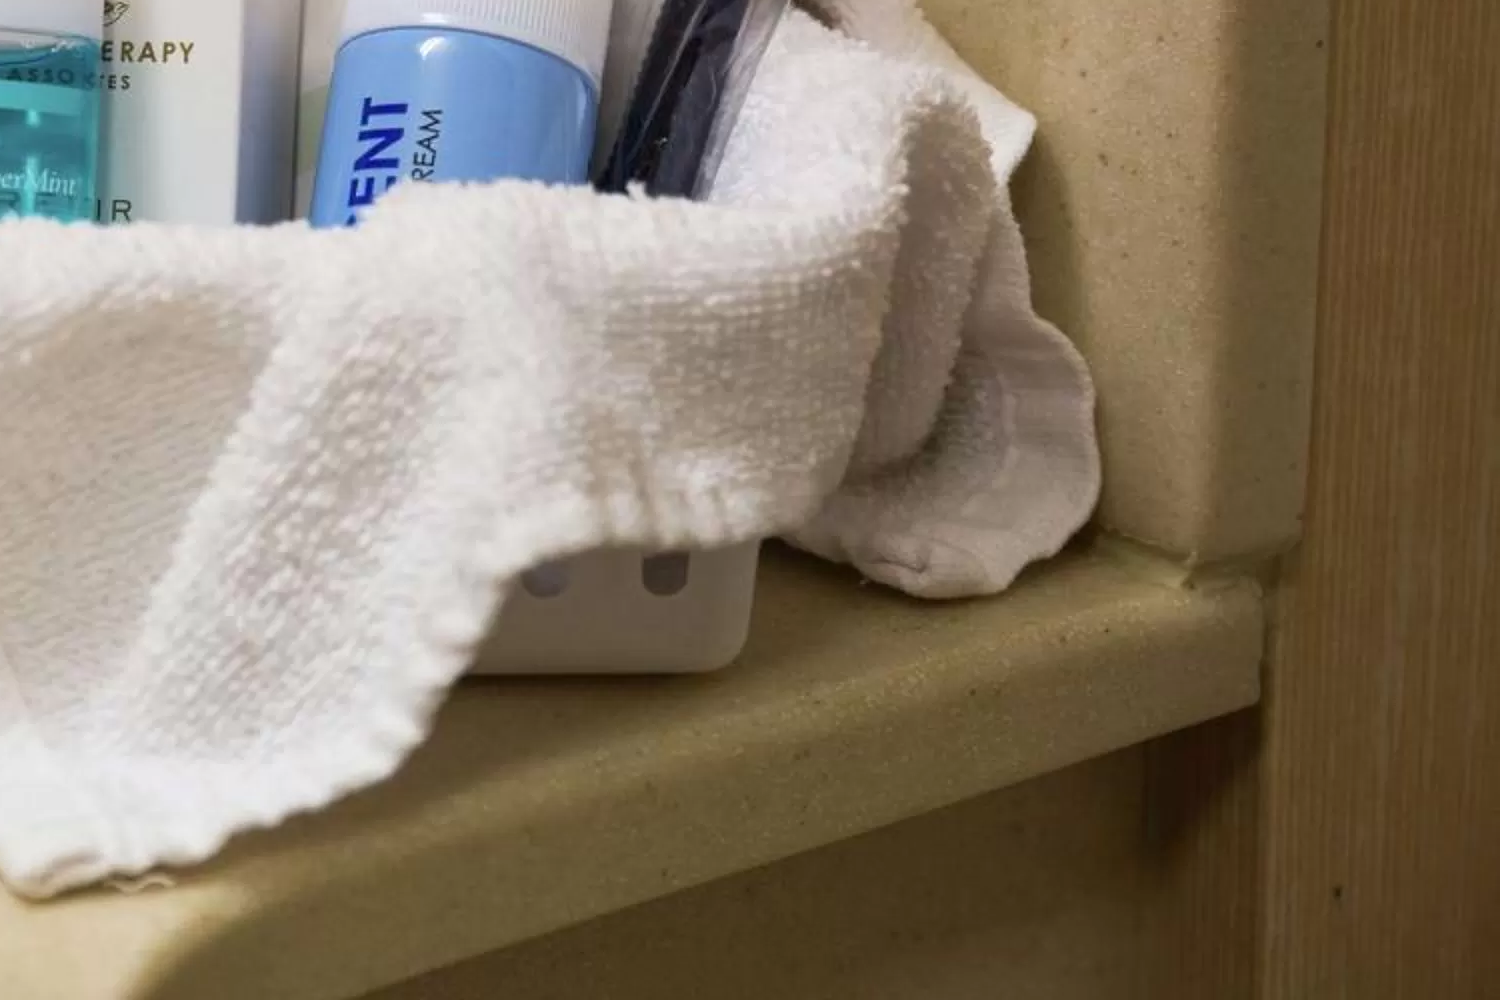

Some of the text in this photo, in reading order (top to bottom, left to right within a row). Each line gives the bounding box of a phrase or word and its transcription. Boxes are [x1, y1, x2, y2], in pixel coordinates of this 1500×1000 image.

[101, 40, 194, 63] ERAPY
[345, 97, 408, 226] ENT
[412, 109, 443, 182] REAM
